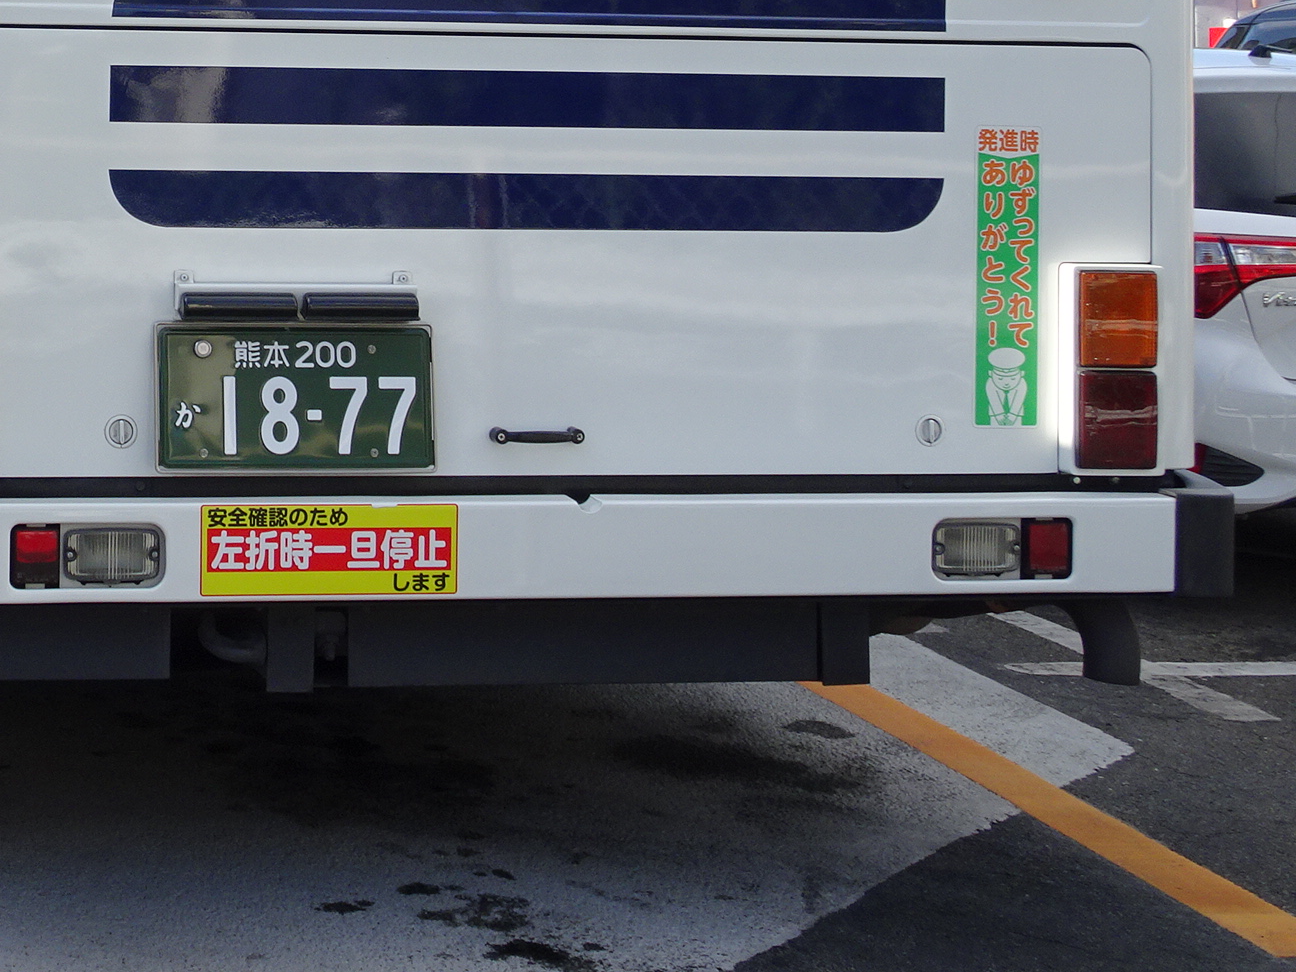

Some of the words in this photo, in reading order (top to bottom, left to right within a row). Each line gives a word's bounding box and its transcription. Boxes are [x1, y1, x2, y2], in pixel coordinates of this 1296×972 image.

[978, 128, 1039, 154] 発進時
[1009, 160, 1035, 348] ゆずってくれて
[174, 401, 202, 430] か
[221, 375, 418, 456] 18-77
[207, 506, 349, 528] 安全確認のため
[210, 529, 448, 571] 左折時一旦停止
[392, 572, 451, 592] します
